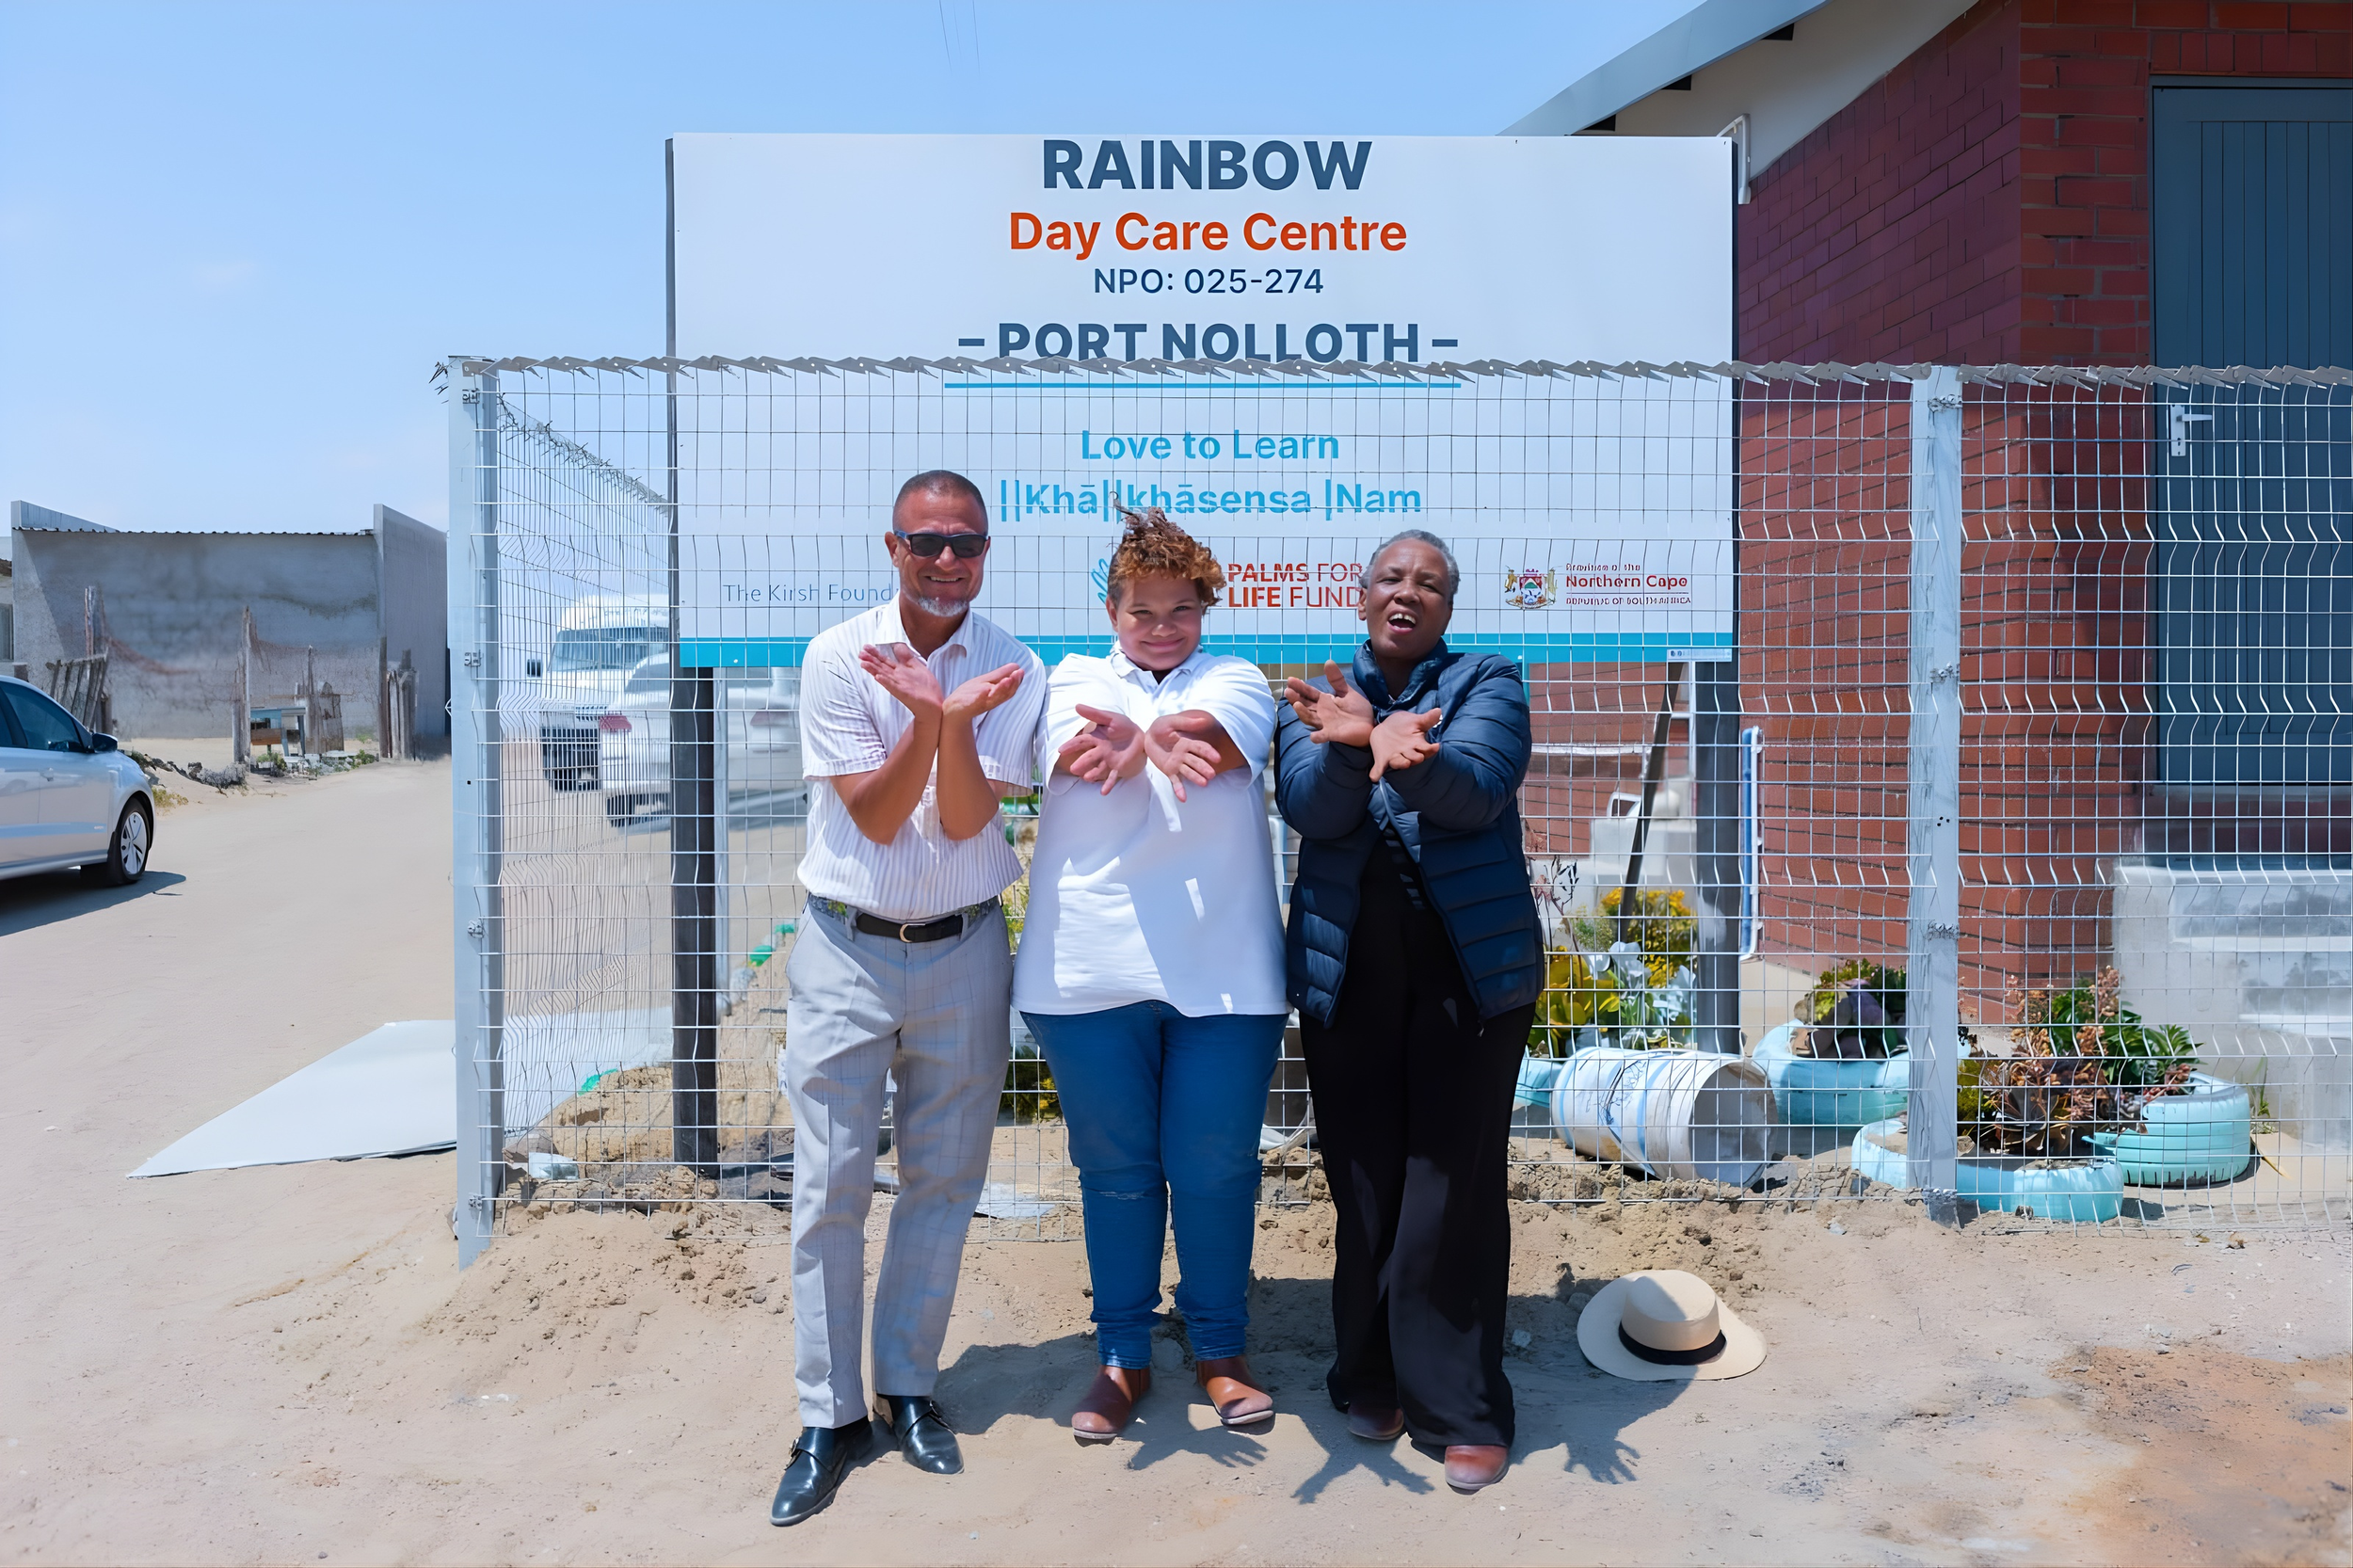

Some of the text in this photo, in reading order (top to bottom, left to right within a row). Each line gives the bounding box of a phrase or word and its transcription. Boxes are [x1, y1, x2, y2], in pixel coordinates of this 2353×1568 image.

[1043, 140, 1372, 191] RAINBOW
[1010, 212, 1407, 260] Day Care Centre
[1095, 268, 1324, 294] NPO: 025-274
[999, 323, 1418, 363] PORT NOLLOTH
[1081, 430, 1339, 460] Love to Learn
[1228, 563, 1362, 583] PALMS FOR
[1566, 574, 1688, 590] Northern Cape
[723, 584, 899, 602] The Kirsh Found
[1228, 586, 1361, 607] LIFE FUND
